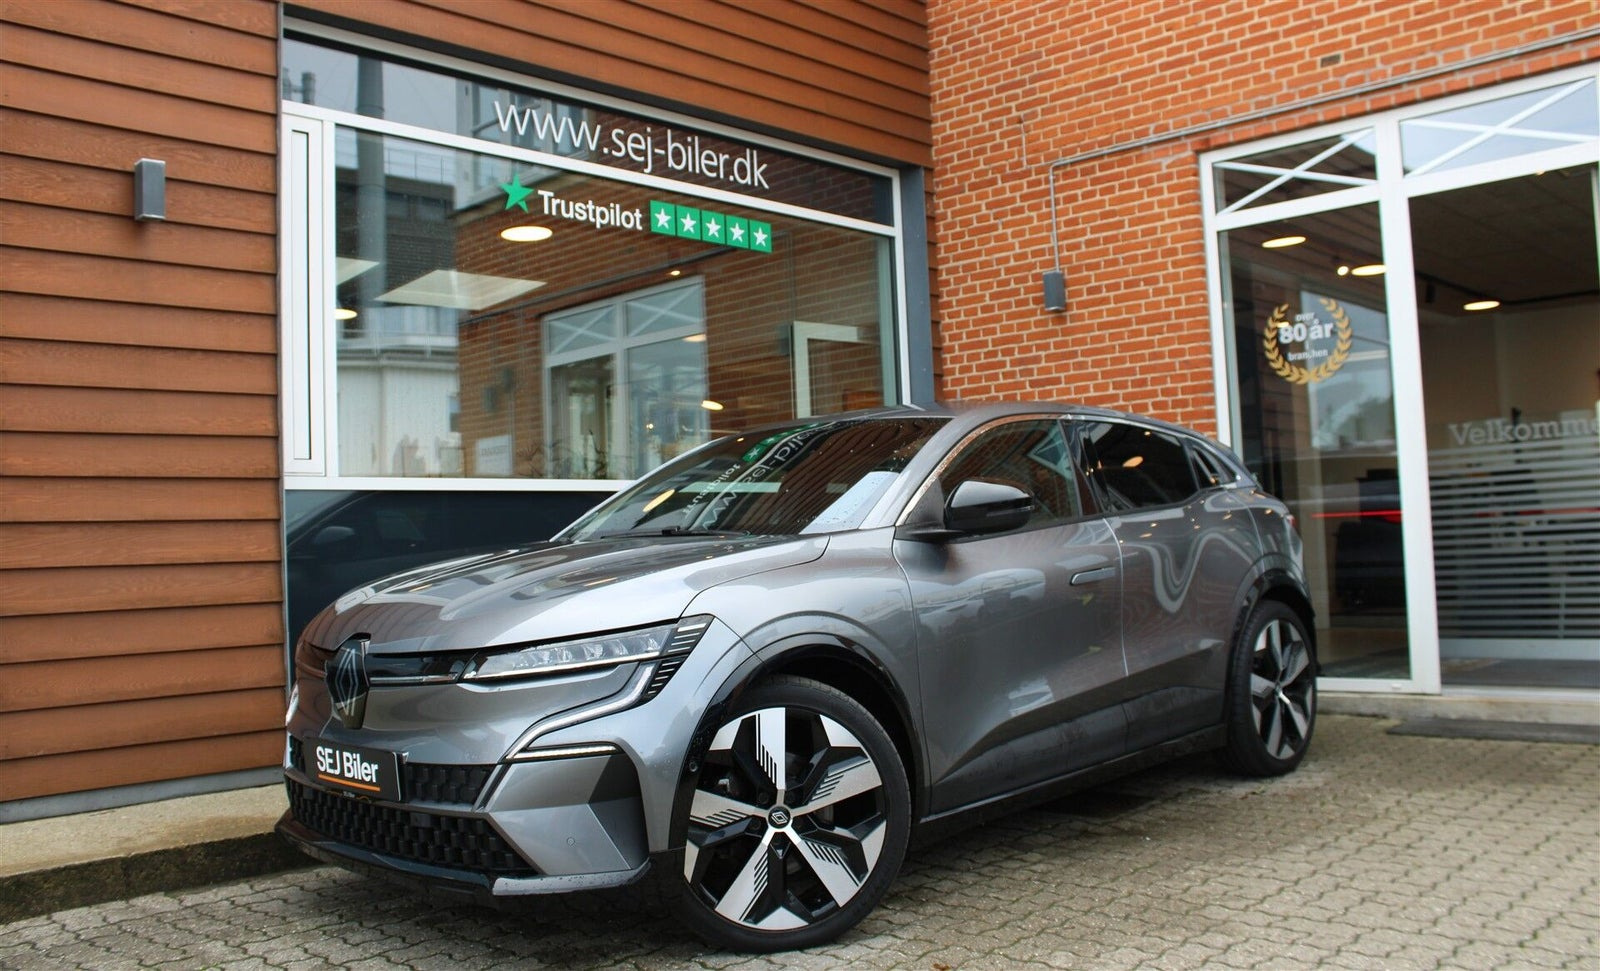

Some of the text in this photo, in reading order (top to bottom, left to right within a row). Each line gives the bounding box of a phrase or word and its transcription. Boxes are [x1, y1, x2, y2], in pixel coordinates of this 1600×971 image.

[494, 100, 770, 190] www.sej-biler.dk
[537, 189, 643, 231] Trustpilot
[1280, 319, 1333, 343] 80 år
[1296, 312, 1315, 322] over
[316, 746, 378, 782] SEJ Biler
